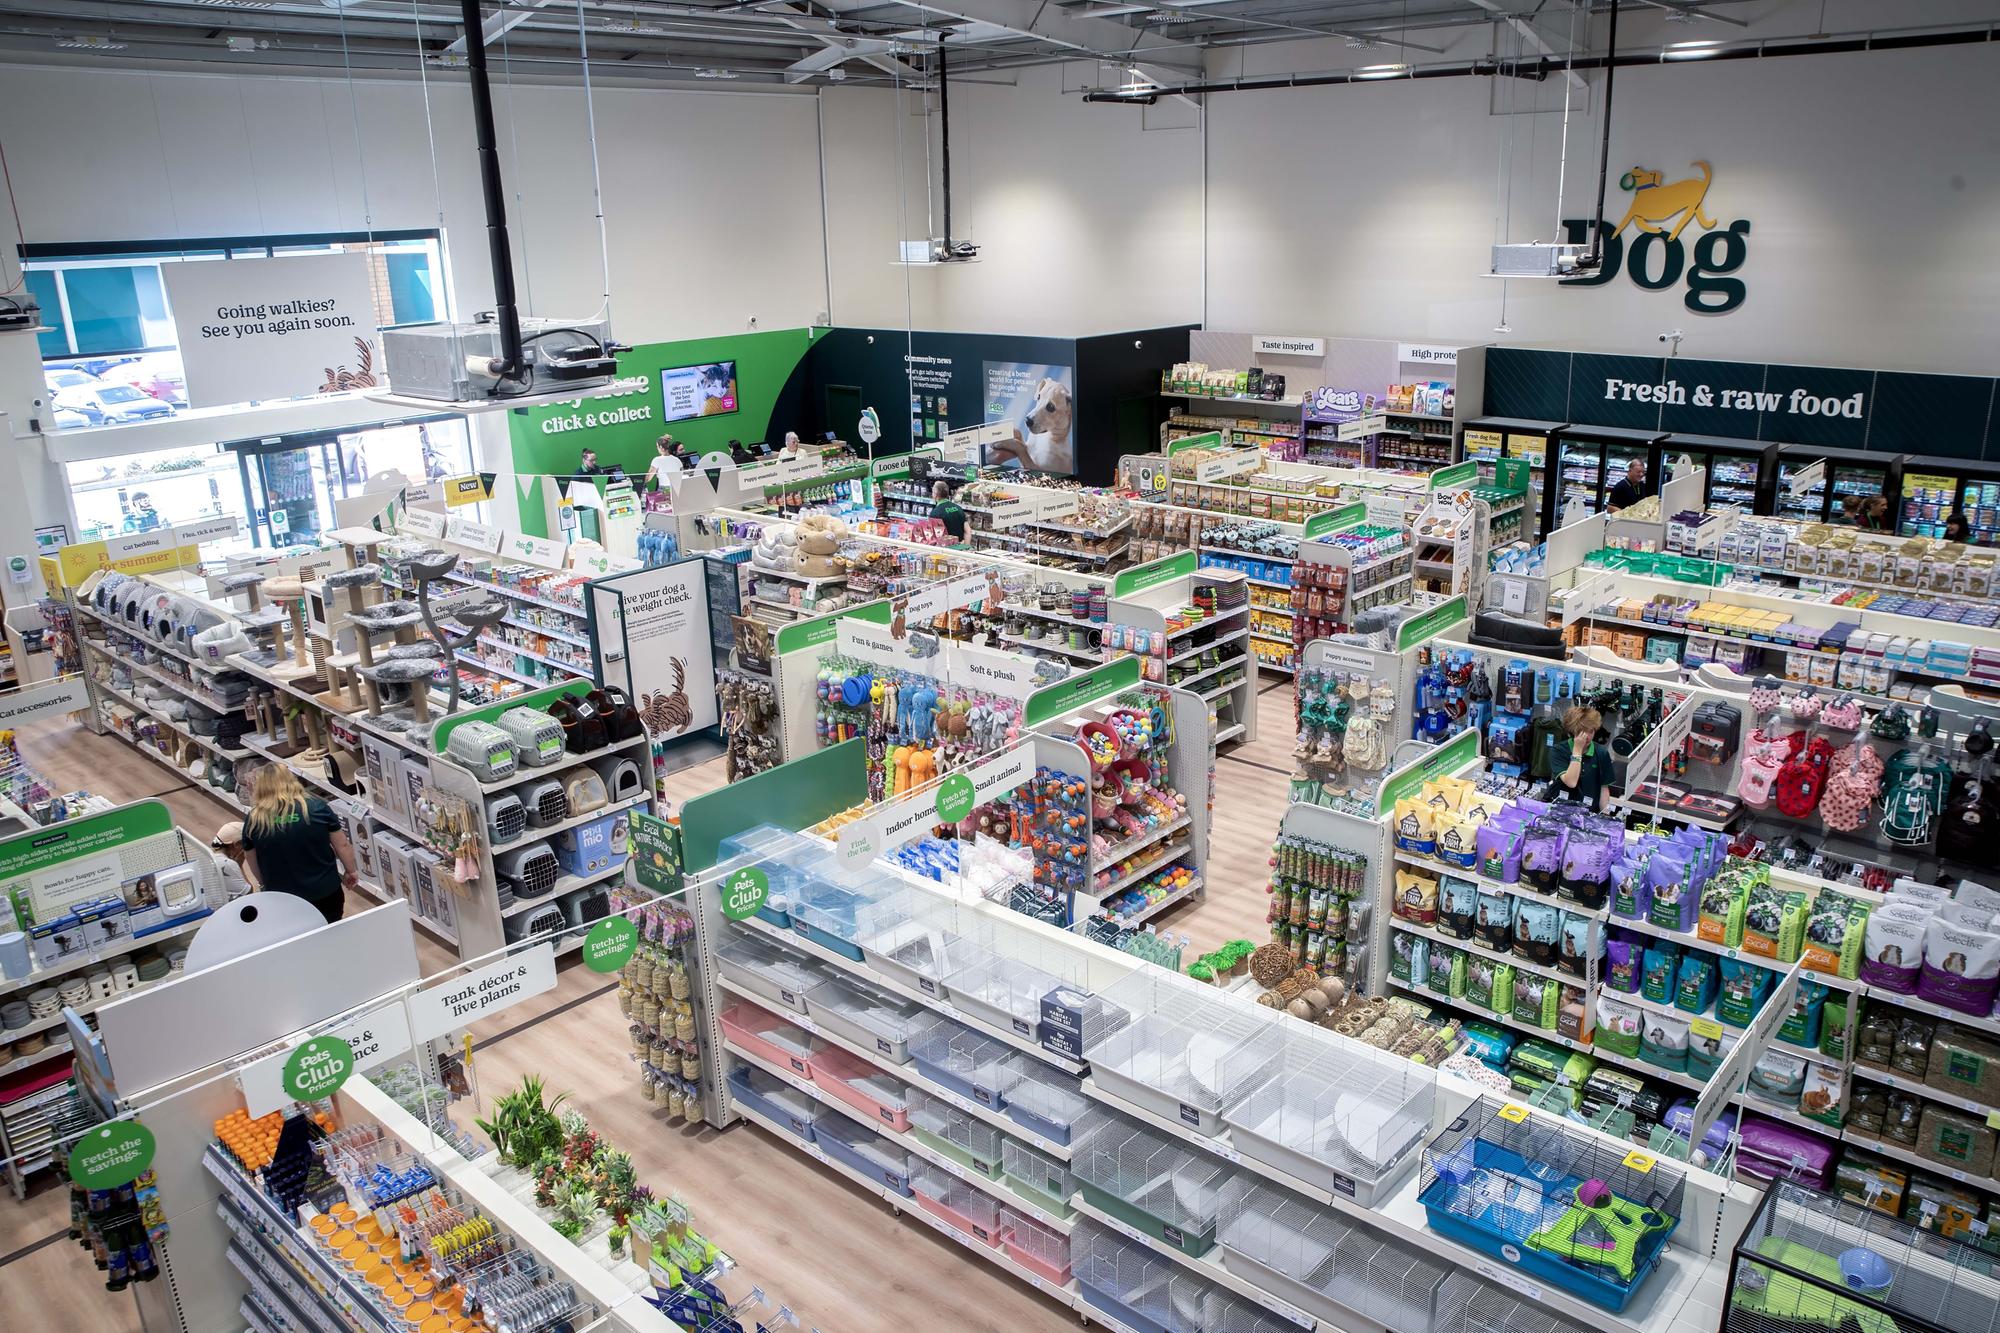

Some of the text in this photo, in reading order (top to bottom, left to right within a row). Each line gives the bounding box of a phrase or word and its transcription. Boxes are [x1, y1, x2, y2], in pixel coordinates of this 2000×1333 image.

[1558, 218, 1750, 314] Dog
[217, 298, 336, 321] Going walkies?
[201, 314, 356, 339] See you again soon.
[1261, 341, 1314, 352] Taste inspired
[904, 354, 952, 365] Community news
[1411, 349, 1457, 361] High prote
[1316, 387, 1361, 412] Years
[1604, 378, 1864, 419] Fresh & raw food
[541, 405, 652, 434] Click & Collect
[1466, 432, 1479, 440] Fresh
[1479, 434, 1489, 442] dog
[878, 460, 910, 473] Loose do
[459, 481, 477, 492] New
[123, 538, 160, 552] Cat bedding
[120, 552, 170, 569] summer
[622, 583, 686, 605] ive your dog a
[963, 582, 986, 596] Dog toys
[632, 591, 692, 613] weight check.
[908, 600, 933, 613] Dog toys
[852, 635, 865, 645] Fun
[871, 641, 894, 653] games
[1325, 652, 1372, 666] Puppy accessories
[970, 664, 1016, 682] Soft & plush
[17, 692, 73, 714] accessories
[975, 762, 1022, 793] Small animal
[942, 787, 969, 805] Fetch the
[944, 797, 970, 812] savings.
[582, 824, 602, 839] Pixi
[643, 821, 660, 837] Excel
[885, 816, 914, 836] Indoor
[13, 826, 124, 863] high sides provide added support
[25, 854, 53, 867] security
[61, 844, 78, 855] help
[78, 841, 95, 851] your
[95, 838, 106, 846] cat
[44, 879, 64, 890] Bowls
[64, 876, 75, 884] for
[75, 870, 96, 881] happy
[733, 877, 755, 892] Pets
[729, 887, 762, 909] Club
[1906, 886, 1940, 902] Selective
[736, 902, 756, 914] Prices
[1889, 908, 1923, 922] Selective
[1701, 921, 1721, 933] Excel
[1880, 924, 1915, 940] Selective
[591, 932, 630, 951] Fetch the
[1745, 936, 1770, 949] Excel
[1943, 931, 1984, 950] Selective
[593, 942, 629, 959] savings.
[1393, 963, 1408, 974] Excel
[441, 965, 528, 1008] Tank décor &
[1430, 975, 1446, 987] Excel
[452, 980, 521, 1018] live plants
[1468, 989, 1486, 1003] Excel
[1049, 1009, 1068, 1021] HABITAT
[1515, 1007, 1536, 1020] Excel
[1604, 1005, 1633, 1017] Selective
[1061, 1019, 1071, 1027] SET
[1560, 1016, 1577, 1028] Excel
[363, 1029, 374, 1041] &
[299, 1048, 331, 1070] Pets
[295, 1060, 345, 1089] Club
[309, 1076, 337, 1095] Prices
[81, 1137, 142, 1168] Fetch the
[87, 1150, 142, 1176] savings.
